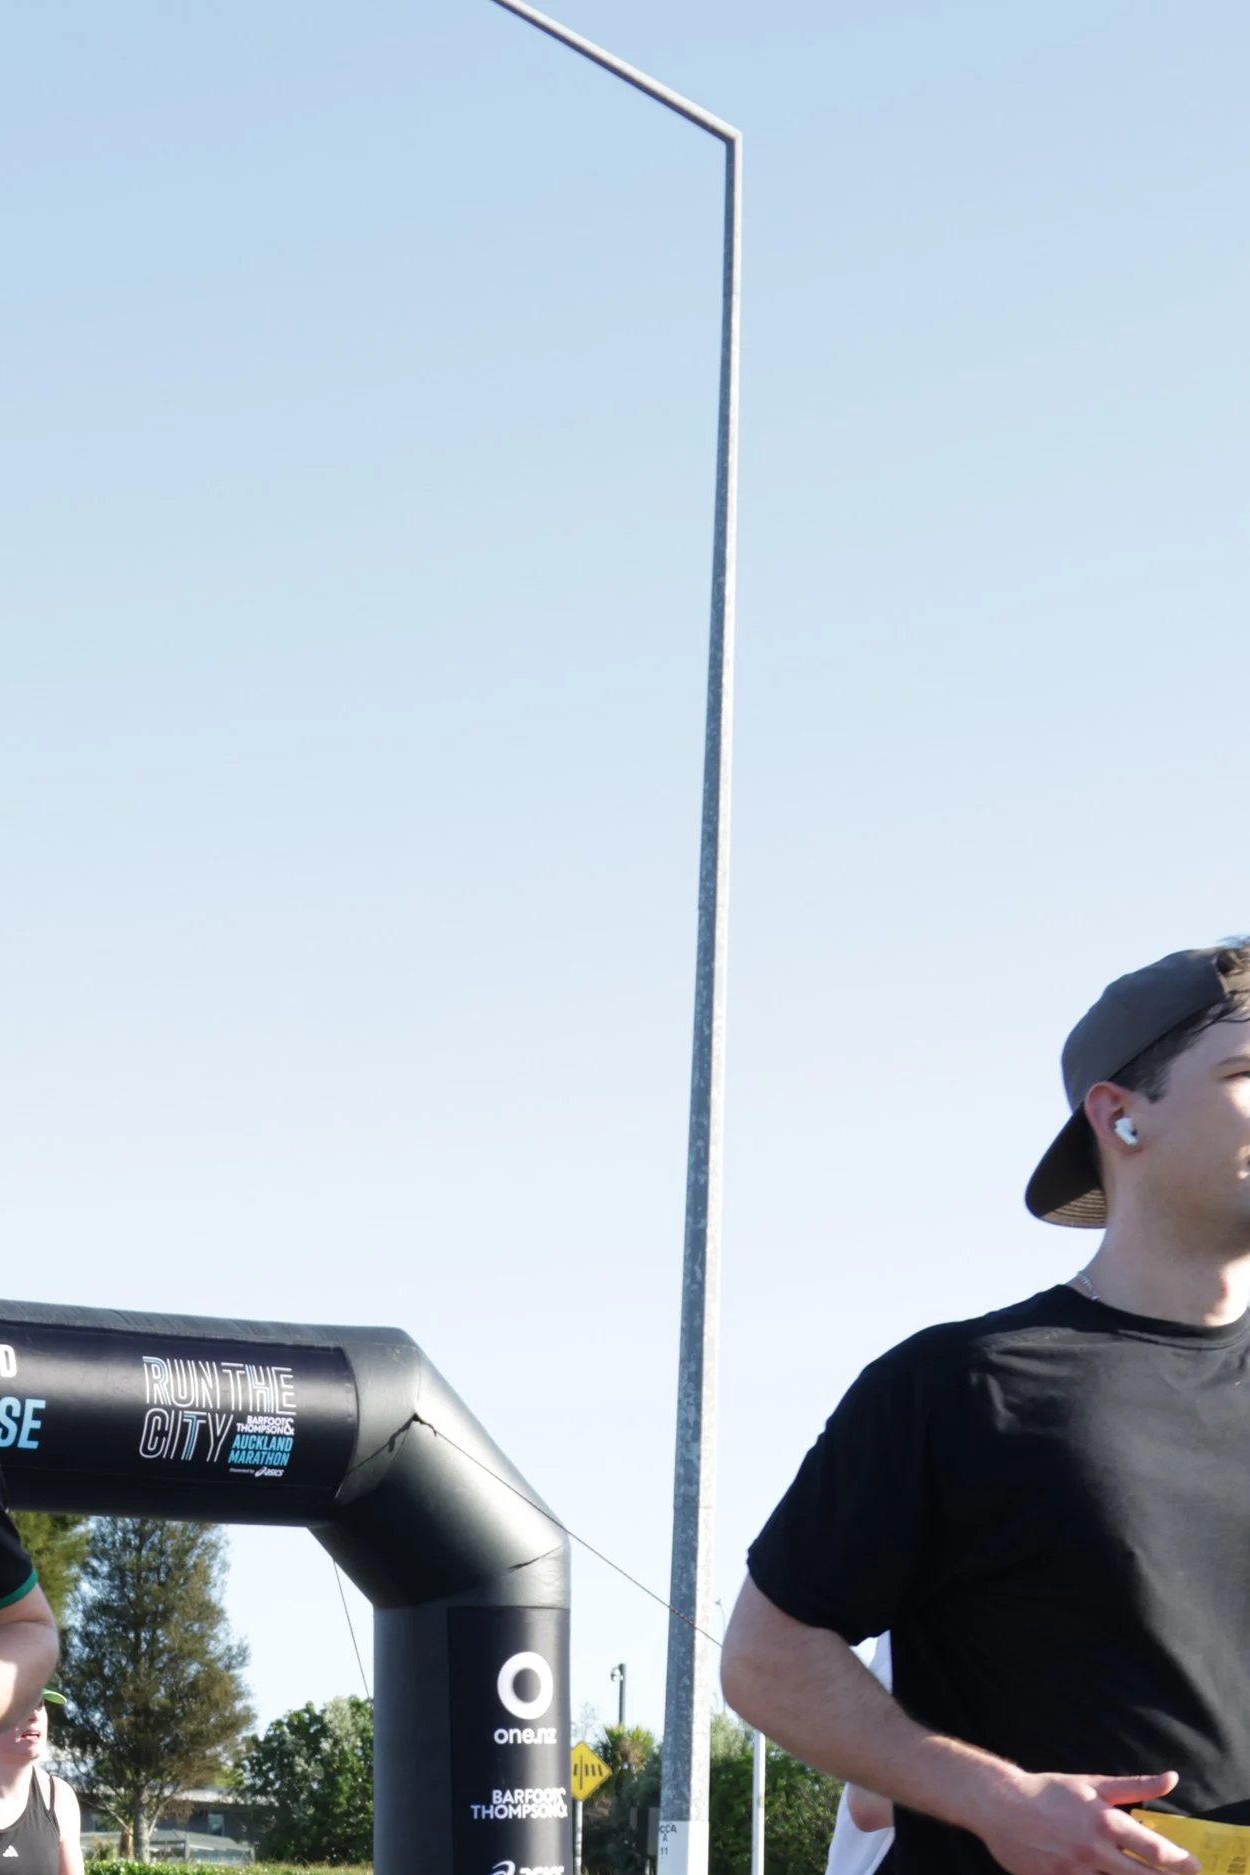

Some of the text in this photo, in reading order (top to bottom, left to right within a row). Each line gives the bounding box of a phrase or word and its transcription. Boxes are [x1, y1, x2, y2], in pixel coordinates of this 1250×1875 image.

[142, 1356, 297, 1415] RUN THE
[236, 1422, 283, 1434] THOMPSON
[247, 1415, 284, 1427] BARFOOT
[139, 1408, 234, 1462] CITY
[232, 1434, 294, 1452] AUCKLAND
[228, 1449, 290, 1466] MARATHON
[493, 1728, 557, 1745] one.nz
[492, 1787, 557, 1805] BARFOOT
[470, 1803, 558, 1819] THOMPSON
